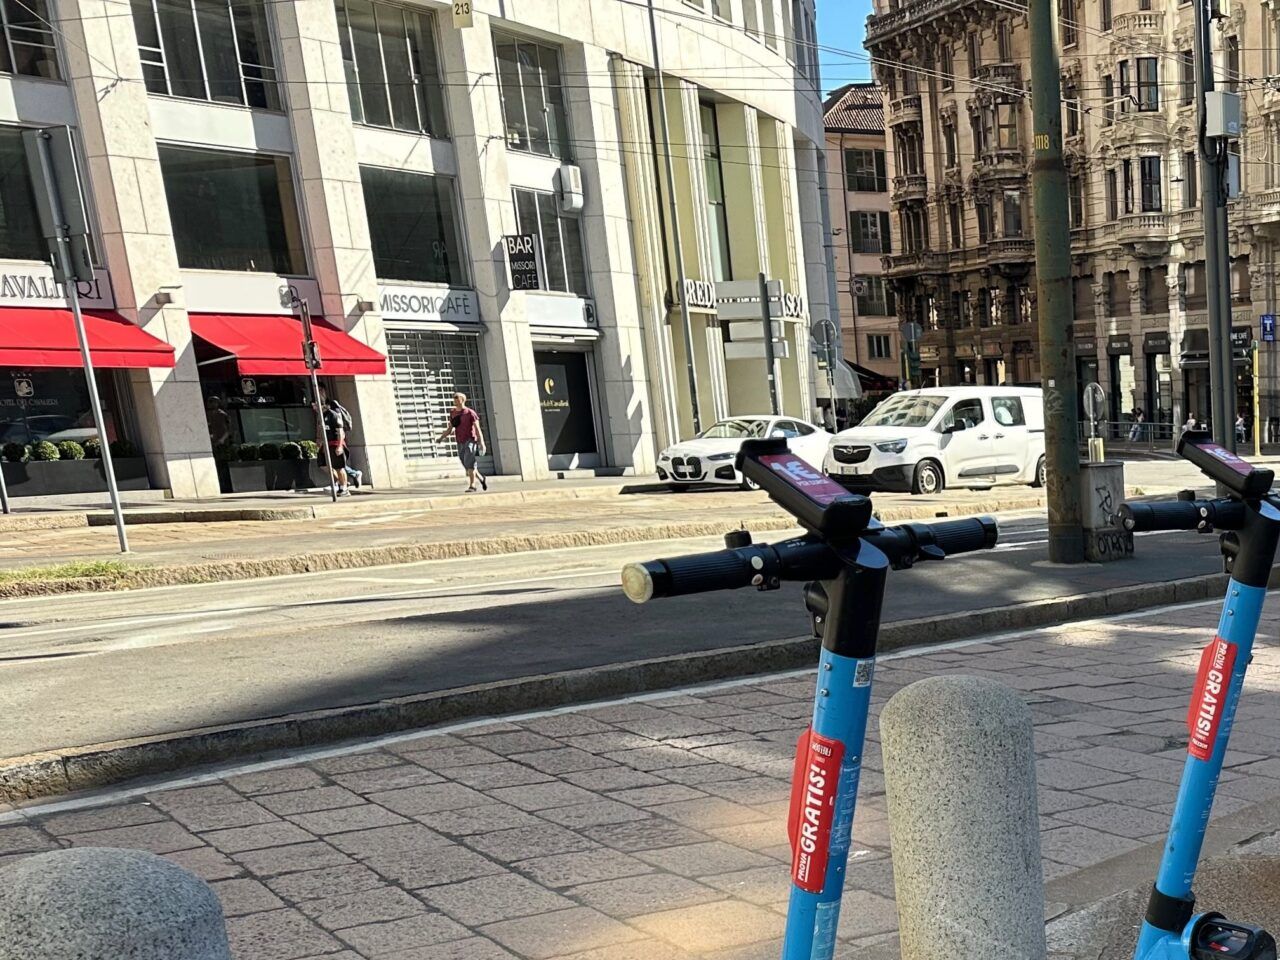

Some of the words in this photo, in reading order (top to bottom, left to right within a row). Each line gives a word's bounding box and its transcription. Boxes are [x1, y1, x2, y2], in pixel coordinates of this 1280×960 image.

[454, 2, 470, 15] 213
[508, 236, 533, 254] BAR
[511, 260, 536, 270] MISSORI
[513, 271, 538, 288] CAFÈ
[1214, 642, 1227, 669] PROVA
[1196, 669, 1223, 737] GRATIS!
[802, 764, 827, 853] GRATIS!
[797, 851, 809, 881] PROVA
